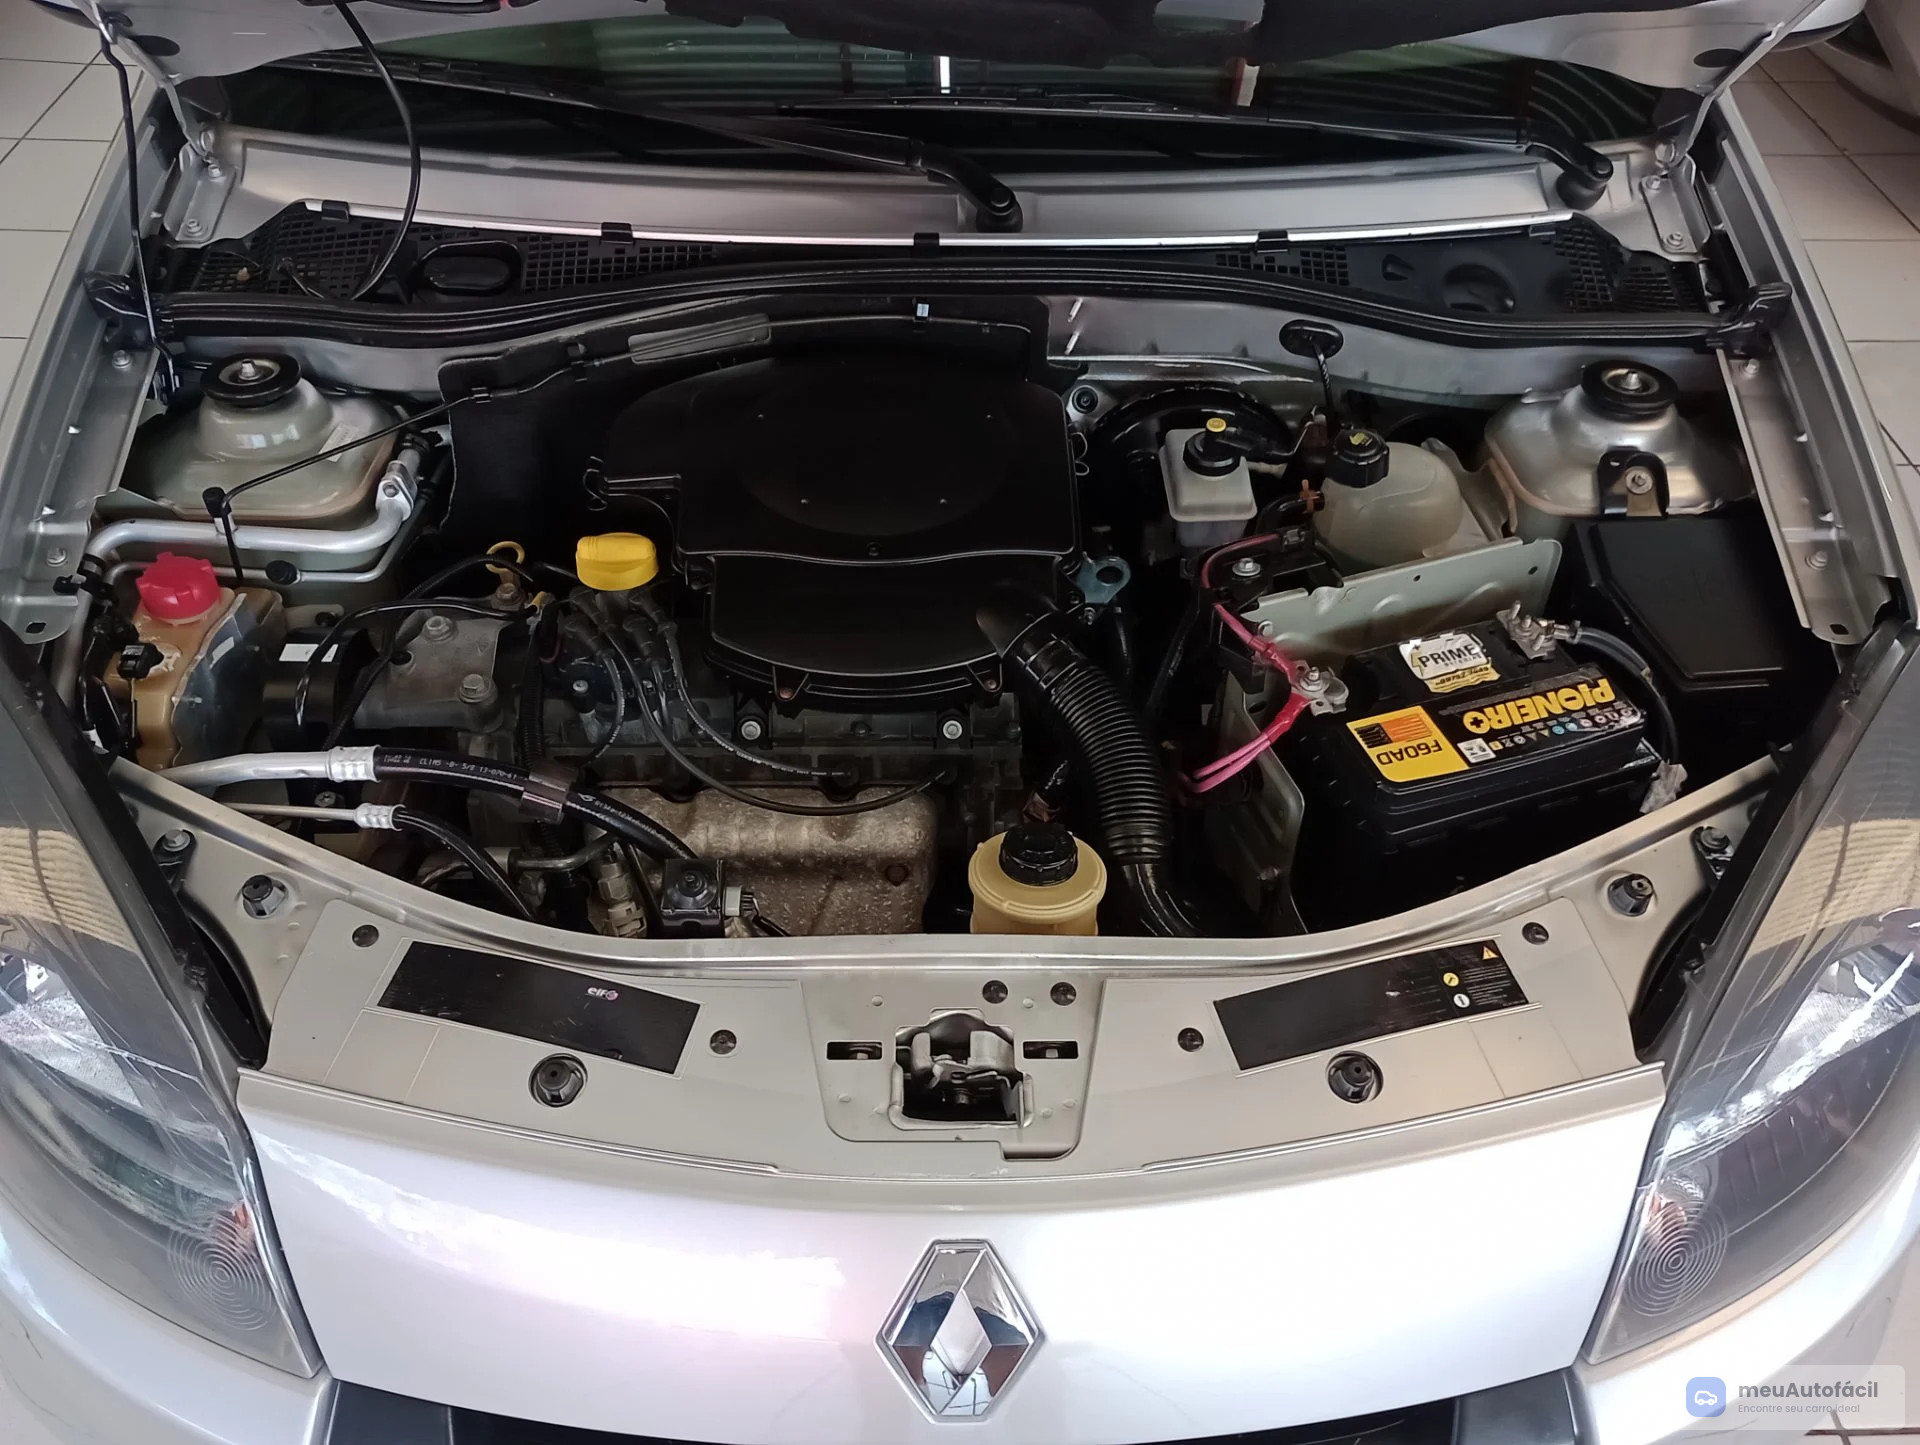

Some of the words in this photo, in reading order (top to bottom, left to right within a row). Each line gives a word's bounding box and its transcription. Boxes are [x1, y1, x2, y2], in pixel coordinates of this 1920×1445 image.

[1418, 643, 1480, 667] PRIME
[1463, 678, 1616, 734] PIONEIRO
[1376, 739, 1443, 765] F60AD
